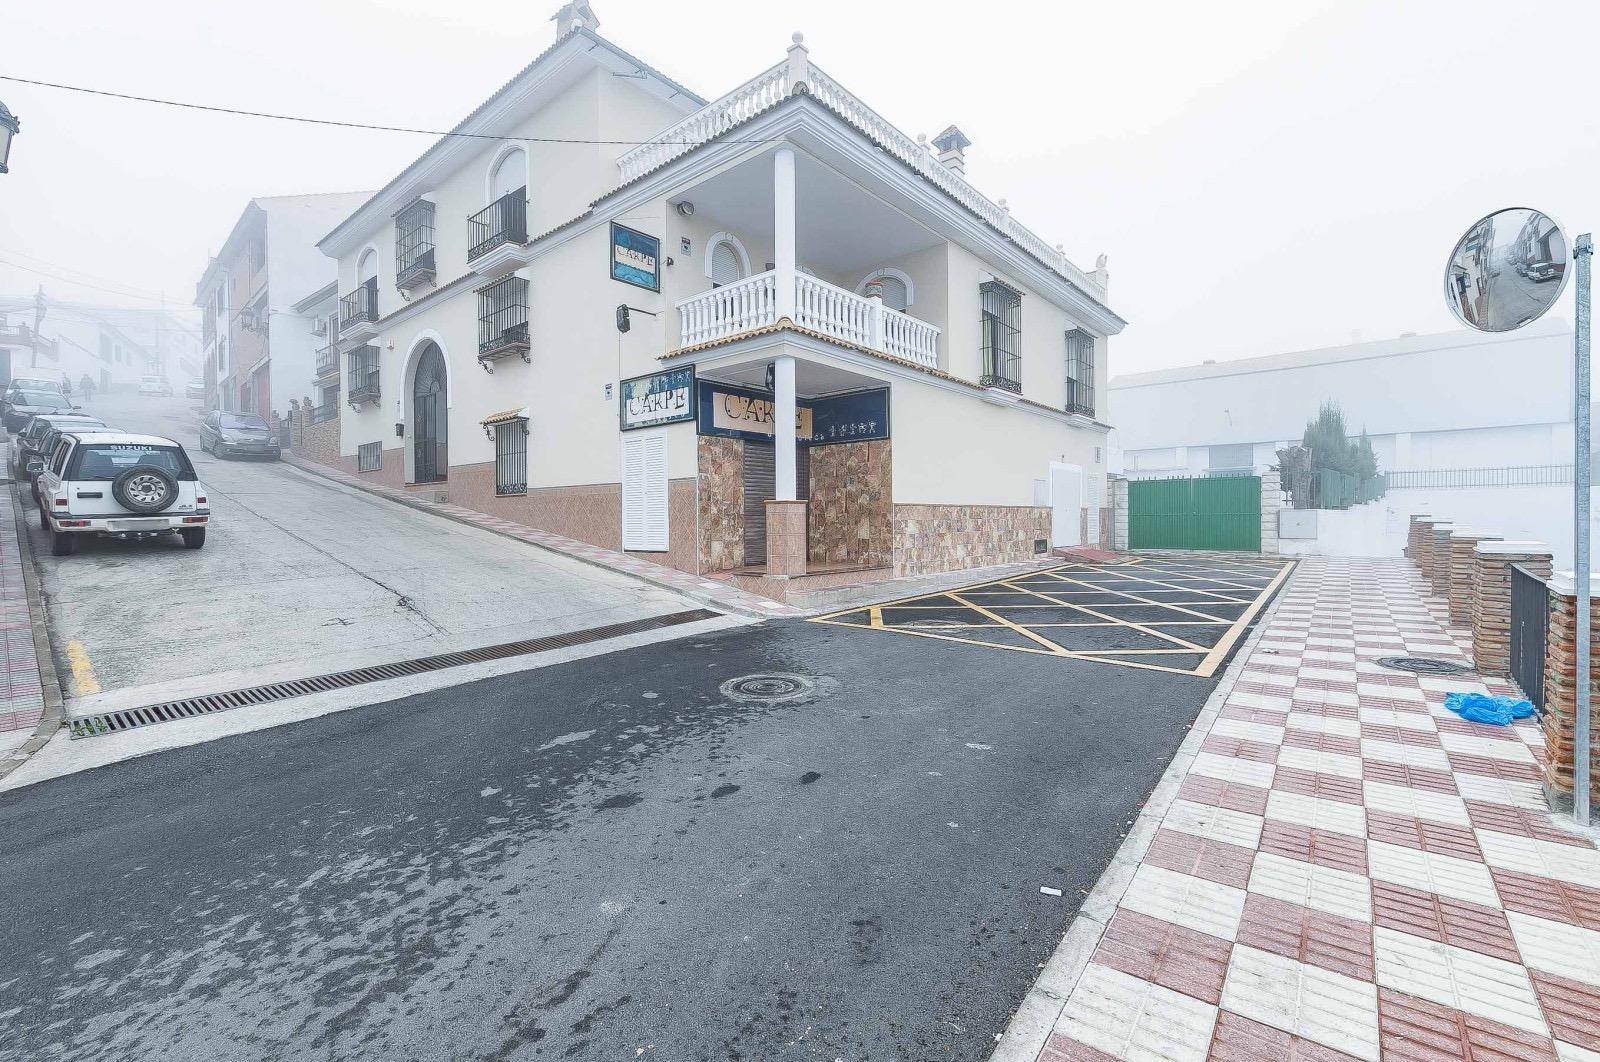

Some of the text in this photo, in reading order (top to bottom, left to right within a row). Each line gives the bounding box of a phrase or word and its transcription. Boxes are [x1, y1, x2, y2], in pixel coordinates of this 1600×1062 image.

[616, 246, 654, 266] CARPE
[629, 387, 685, 416] CARPE
[724, 394, 803, 430] CARE
